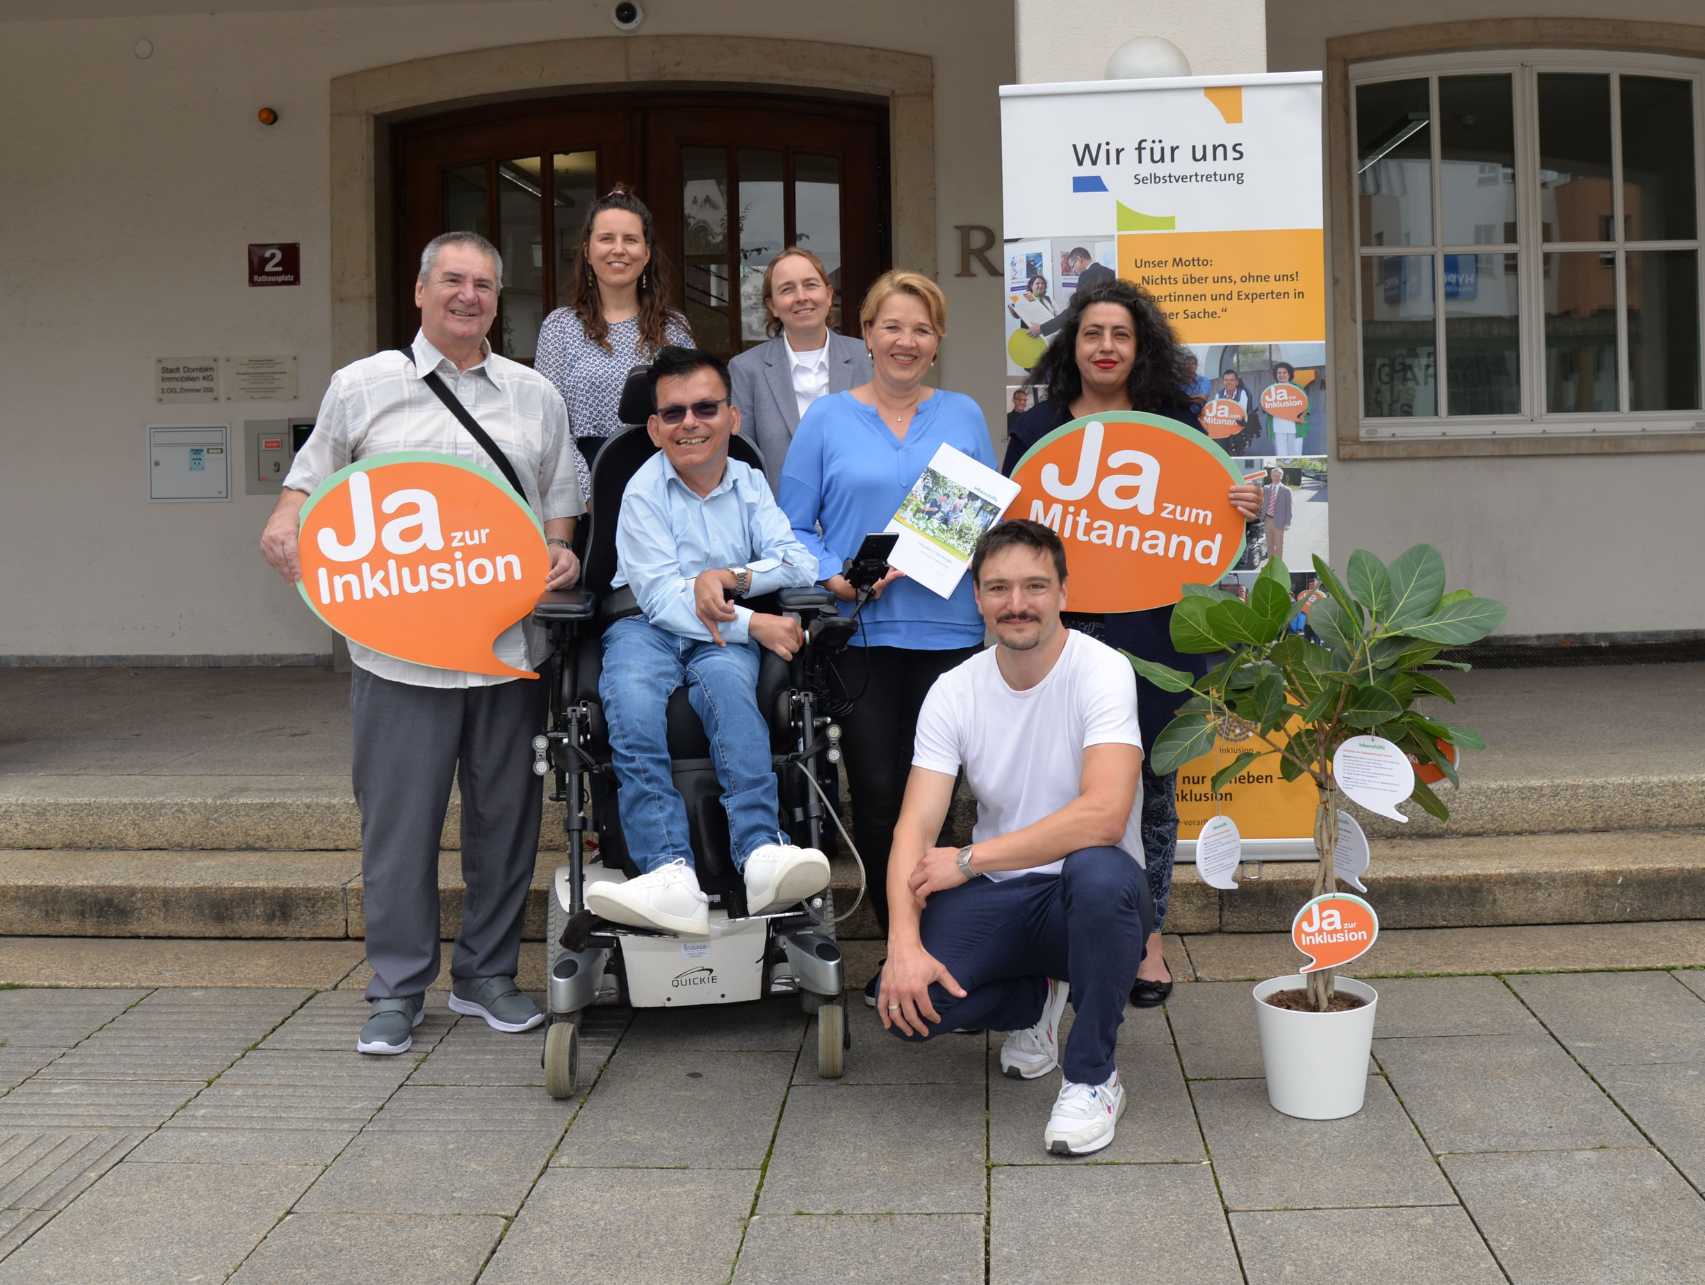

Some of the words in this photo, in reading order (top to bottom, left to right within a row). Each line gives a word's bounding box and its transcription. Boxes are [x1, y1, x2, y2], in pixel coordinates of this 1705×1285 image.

[1072, 141, 1125, 166] Wir
[1134, 139, 1180, 164] für
[1191, 142, 1244, 162] uns
[1133, 172, 1245, 185] Selbstvertretung
[264, 249, 283, 272] 2
[1134, 258, 1168, 269] Unser
[1172, 256, 1214, 268] Motto:
[1182, 274, 1209, 285] über
[1212, 275, 1237, 286] uns,
[1240, 272, 1271, 283] ohne
[1274, 271, 1299, 282] uns!
[1210, 289, 1233, 301] und
[1237, 289, 1290, 303] Experten
[1293, 288, 1305, 299] in
[1040, 421, 1161, 515] Ja
[1160, 503, 1212, 525] zum
[317, 471, 445, 562] Ja
[451, 528, 490, 548] zur
[1029, 499, 1223, 566] Mitanand
[318, 551, 522, 604] Inklusion
[1182, 775, 1207, 785] nur
[1175, 789, 1233, 802] nklusion
[1302, 903, 1342, 933] Ja
[1301, 930, 1367, 945] Inklusion
[672, 976, 717, 988] QUICKIE
